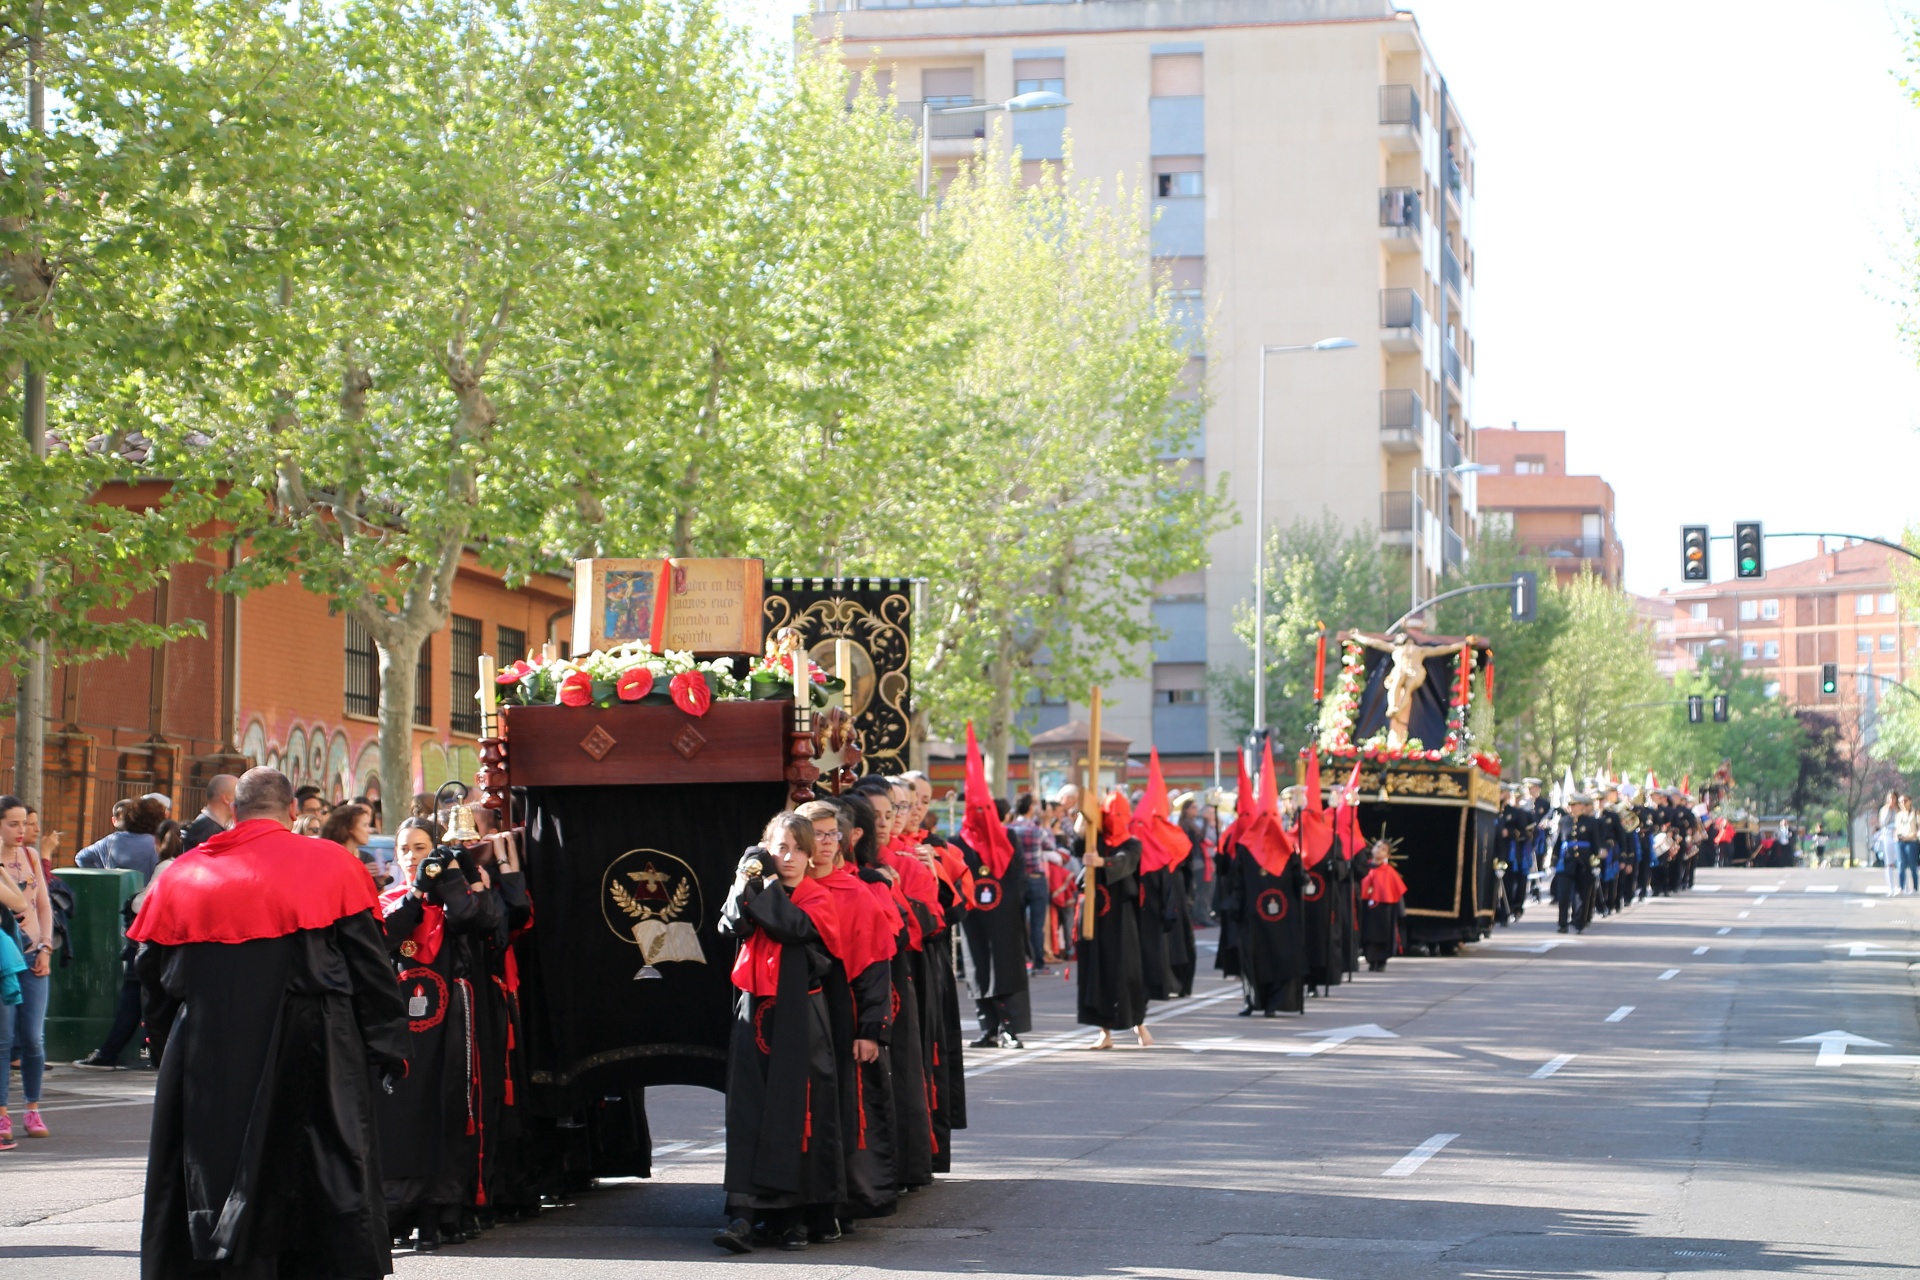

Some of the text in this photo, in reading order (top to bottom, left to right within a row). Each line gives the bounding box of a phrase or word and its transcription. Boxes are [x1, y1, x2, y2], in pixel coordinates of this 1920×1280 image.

[711, 580, 722, 592] en
[674, 598, 706, 610] manos
[673, 613, 730, 626] miendo mi
